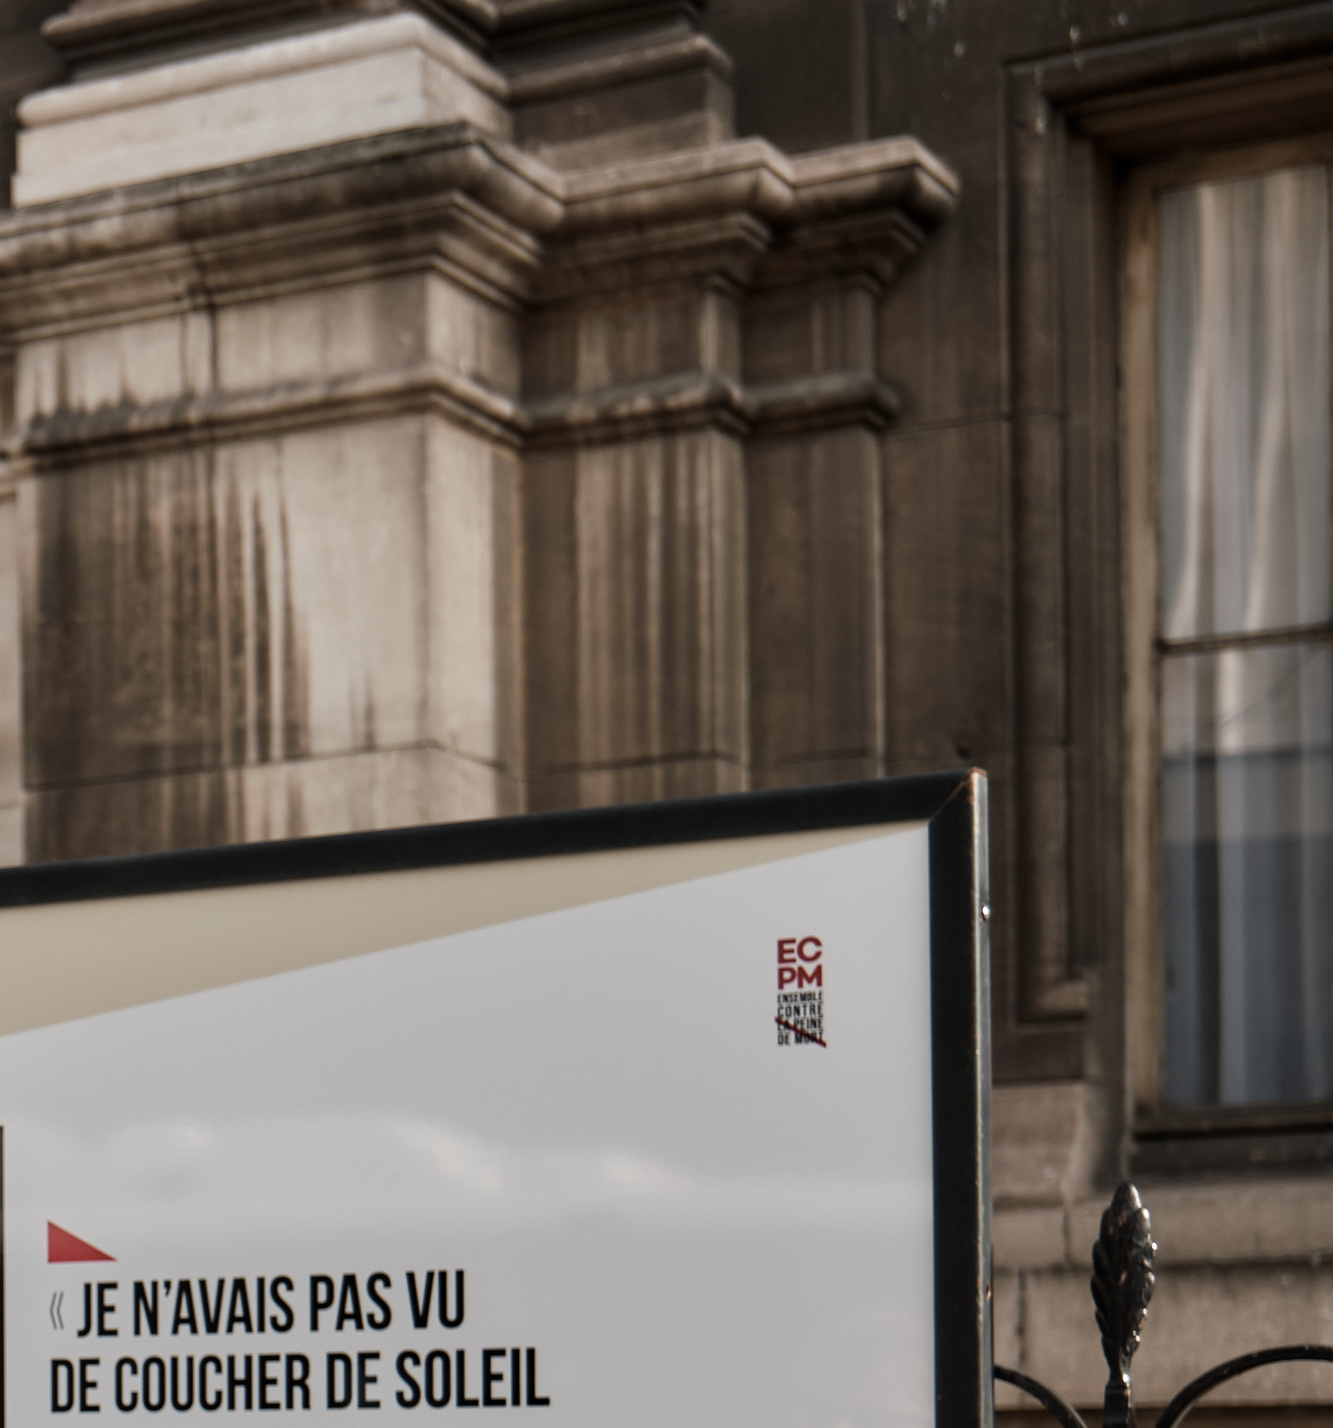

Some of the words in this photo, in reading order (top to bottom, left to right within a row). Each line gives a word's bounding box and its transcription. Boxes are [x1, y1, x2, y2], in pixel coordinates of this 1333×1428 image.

[777, 936, 823, 964] EC
[777, 964, 823, 990] PM
[777, 990, 823, 1004] ENSEMBLE
[777, 1003, 823, 1018] CONTRE
[777, 1031, 791, 1046] DE
[76, 1281, 119, 1339] JE
[133, 1274, 295, 1337] N’AVAIS
[309, 1271, 393, 1333] PAS
[405, 1269, 465, 1330] VU
[50, 1357, 101, 1414] DE
[114, 1352, 312, 1413] COUCHER
[326, 1350, 382, 1410] DE
[395, 1346, 551, 1410] SOLEIL
